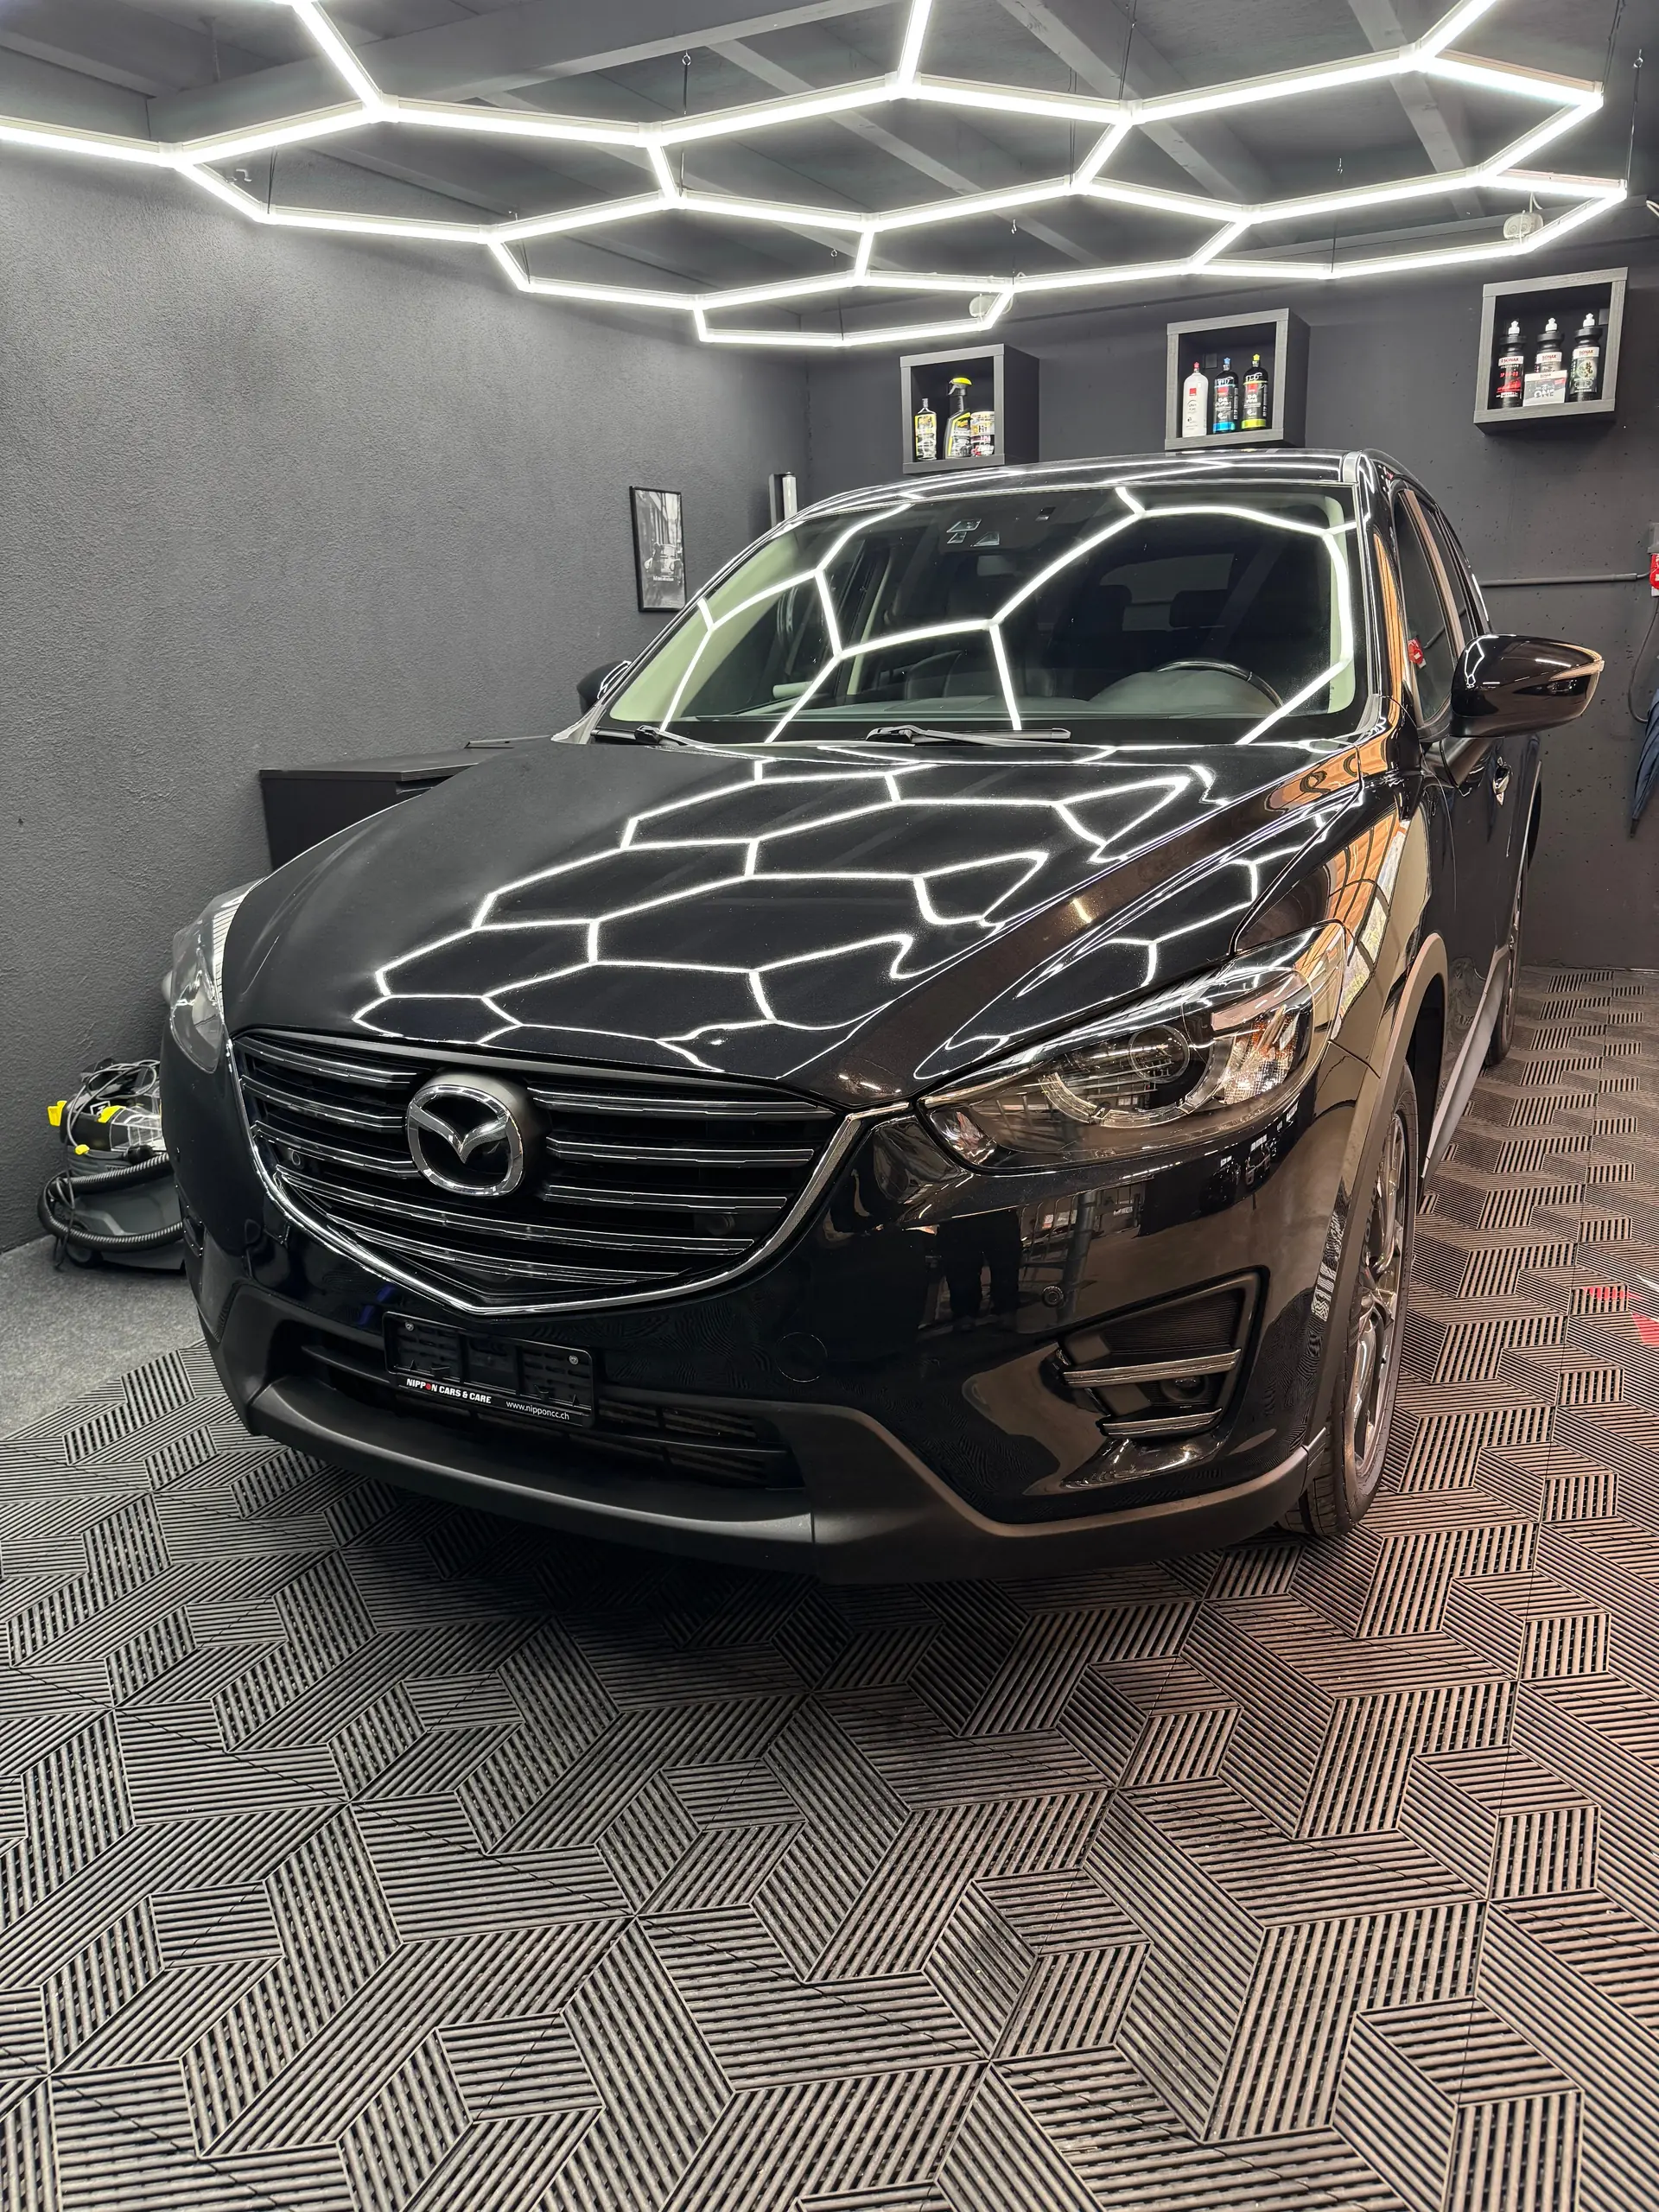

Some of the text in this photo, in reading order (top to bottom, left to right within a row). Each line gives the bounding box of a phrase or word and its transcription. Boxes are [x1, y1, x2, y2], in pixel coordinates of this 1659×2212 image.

[406, 1378, 438, 1392] NIPPON
[439, 1386, 461, 1397] CARS
[469, 1392, 492, 1404] CARE
[505, 1401, 569, 1421] www.nipponcc.ch
